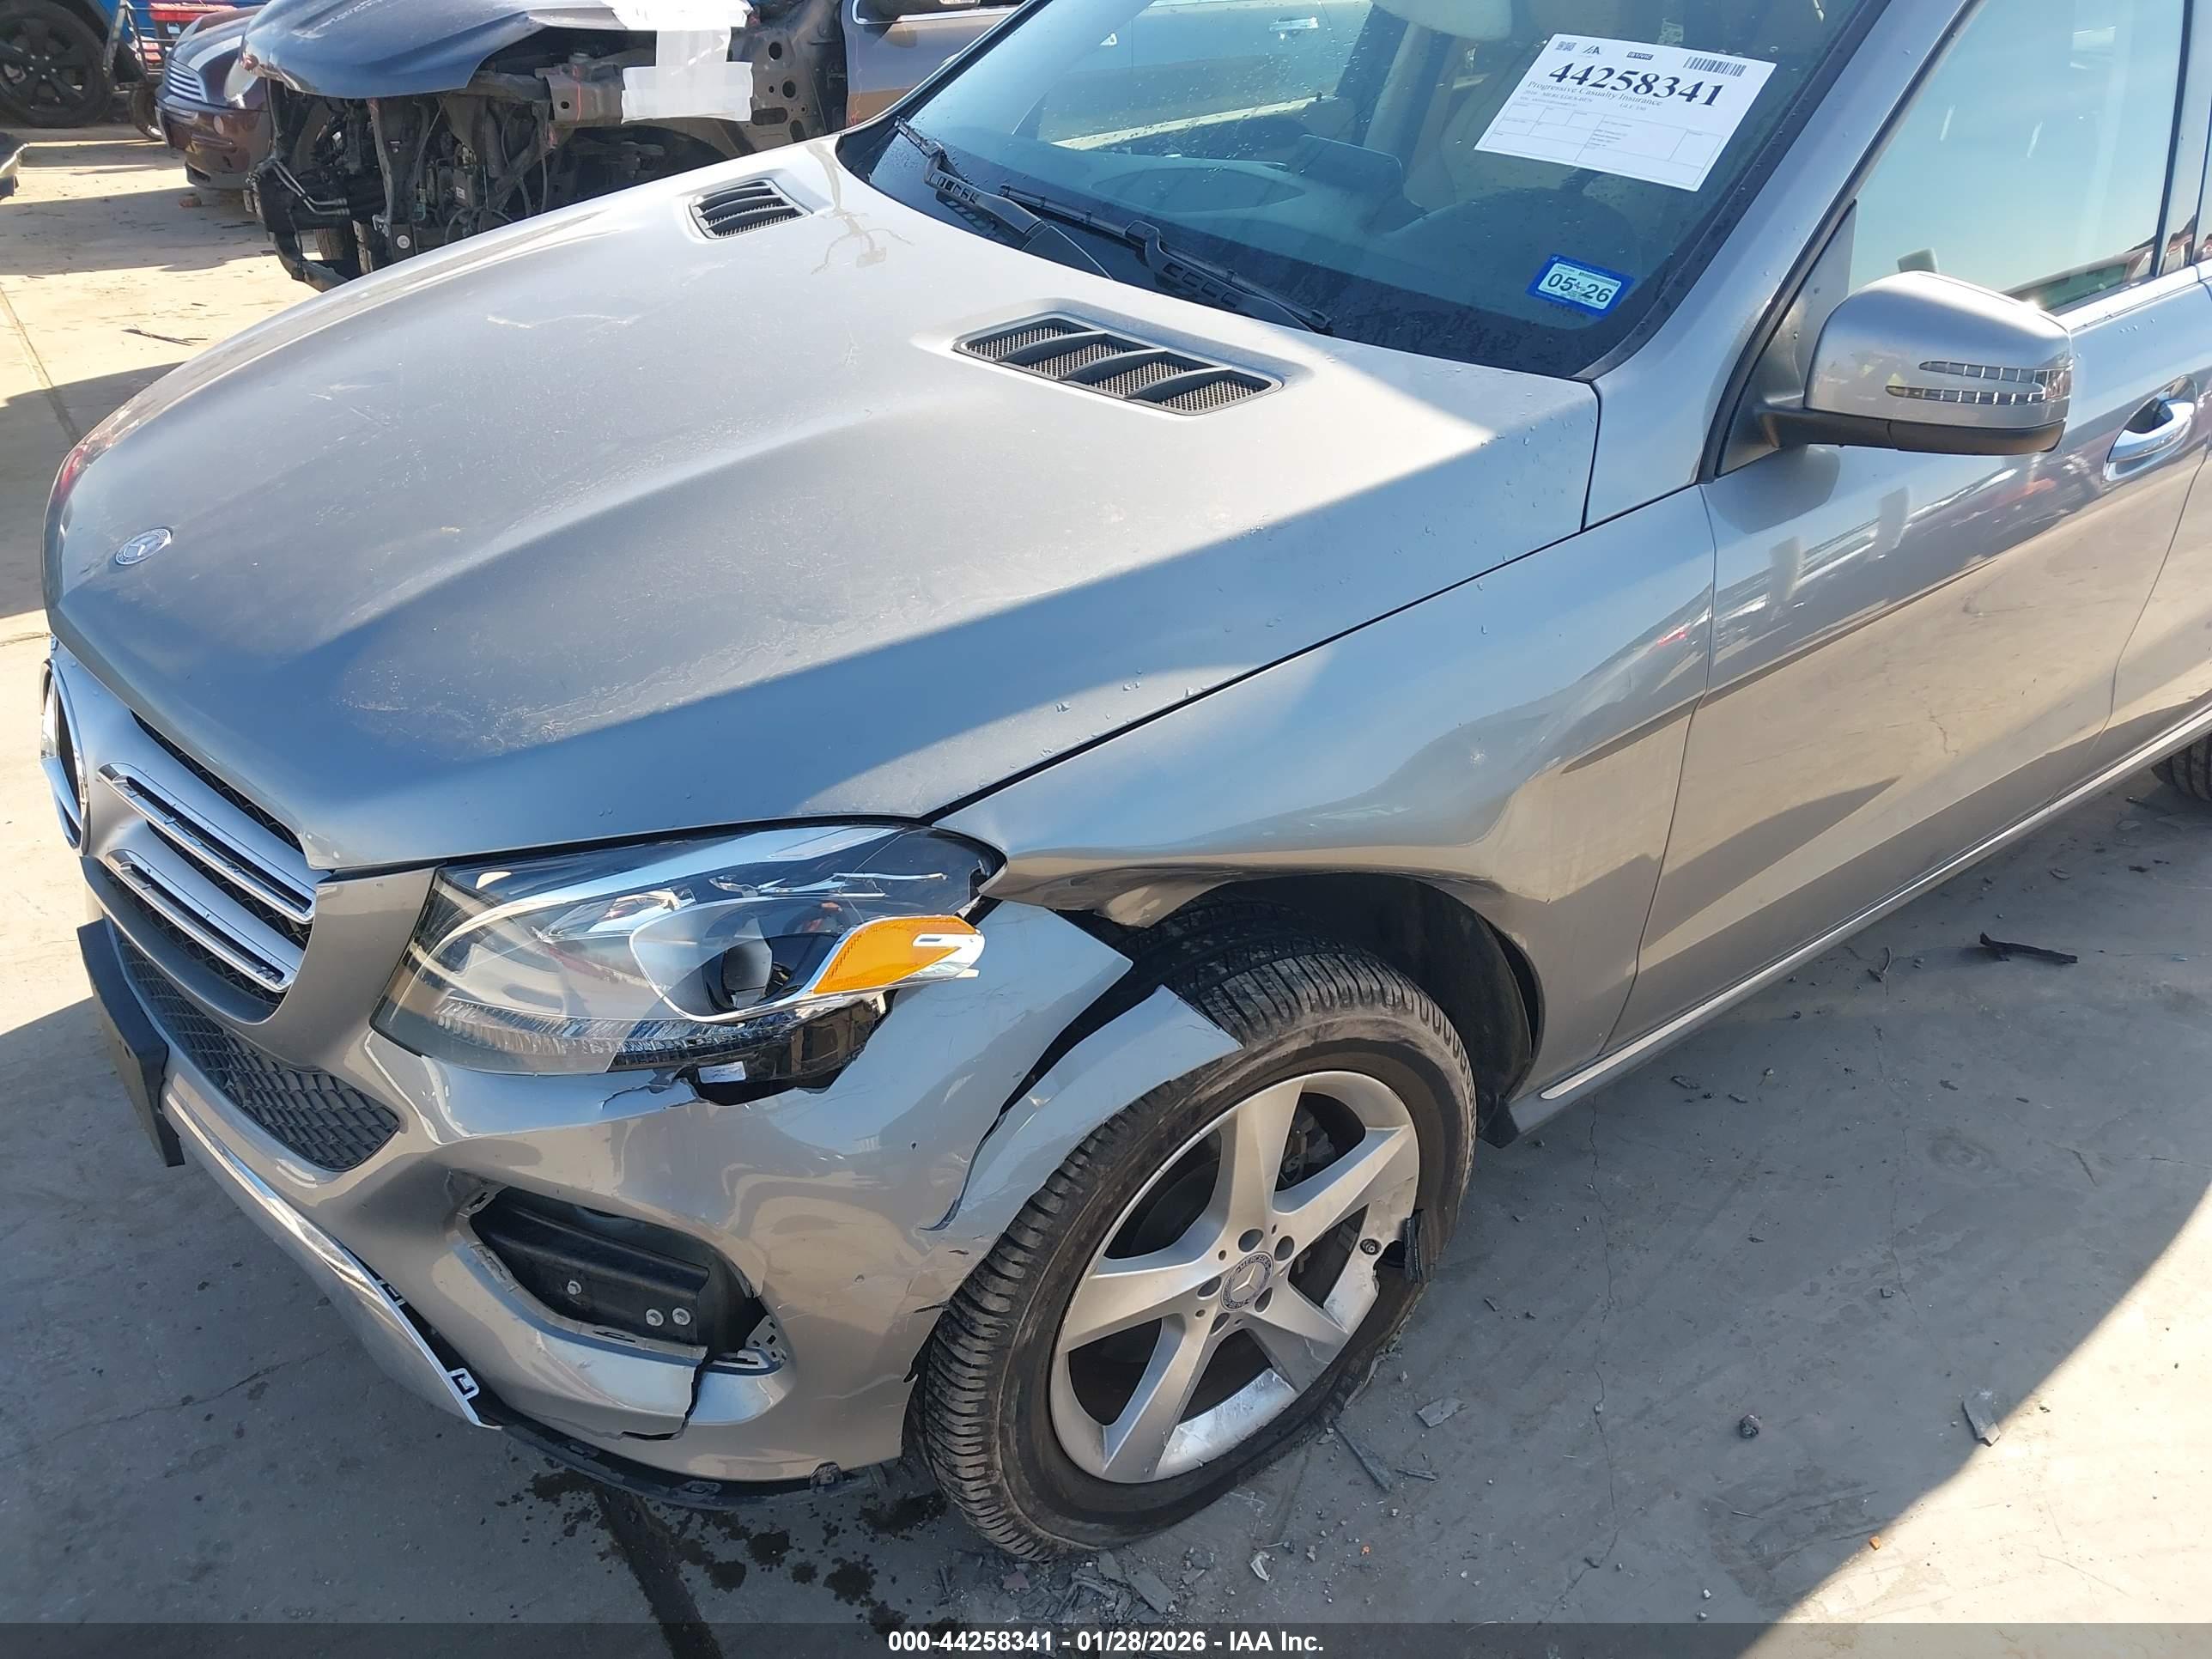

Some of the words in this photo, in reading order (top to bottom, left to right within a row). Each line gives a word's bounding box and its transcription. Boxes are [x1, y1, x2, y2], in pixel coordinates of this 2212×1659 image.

[1528, 81, 1578, 94] Progressive
[1579, 88, 1616, 100] Casualty
[1620, 93, 1663, 106] Insurance
[1548, 62, 1724, 107] 44258341
[1547, 272, 1577, 292] 05
[1581, 283, 1613, 303] 26
